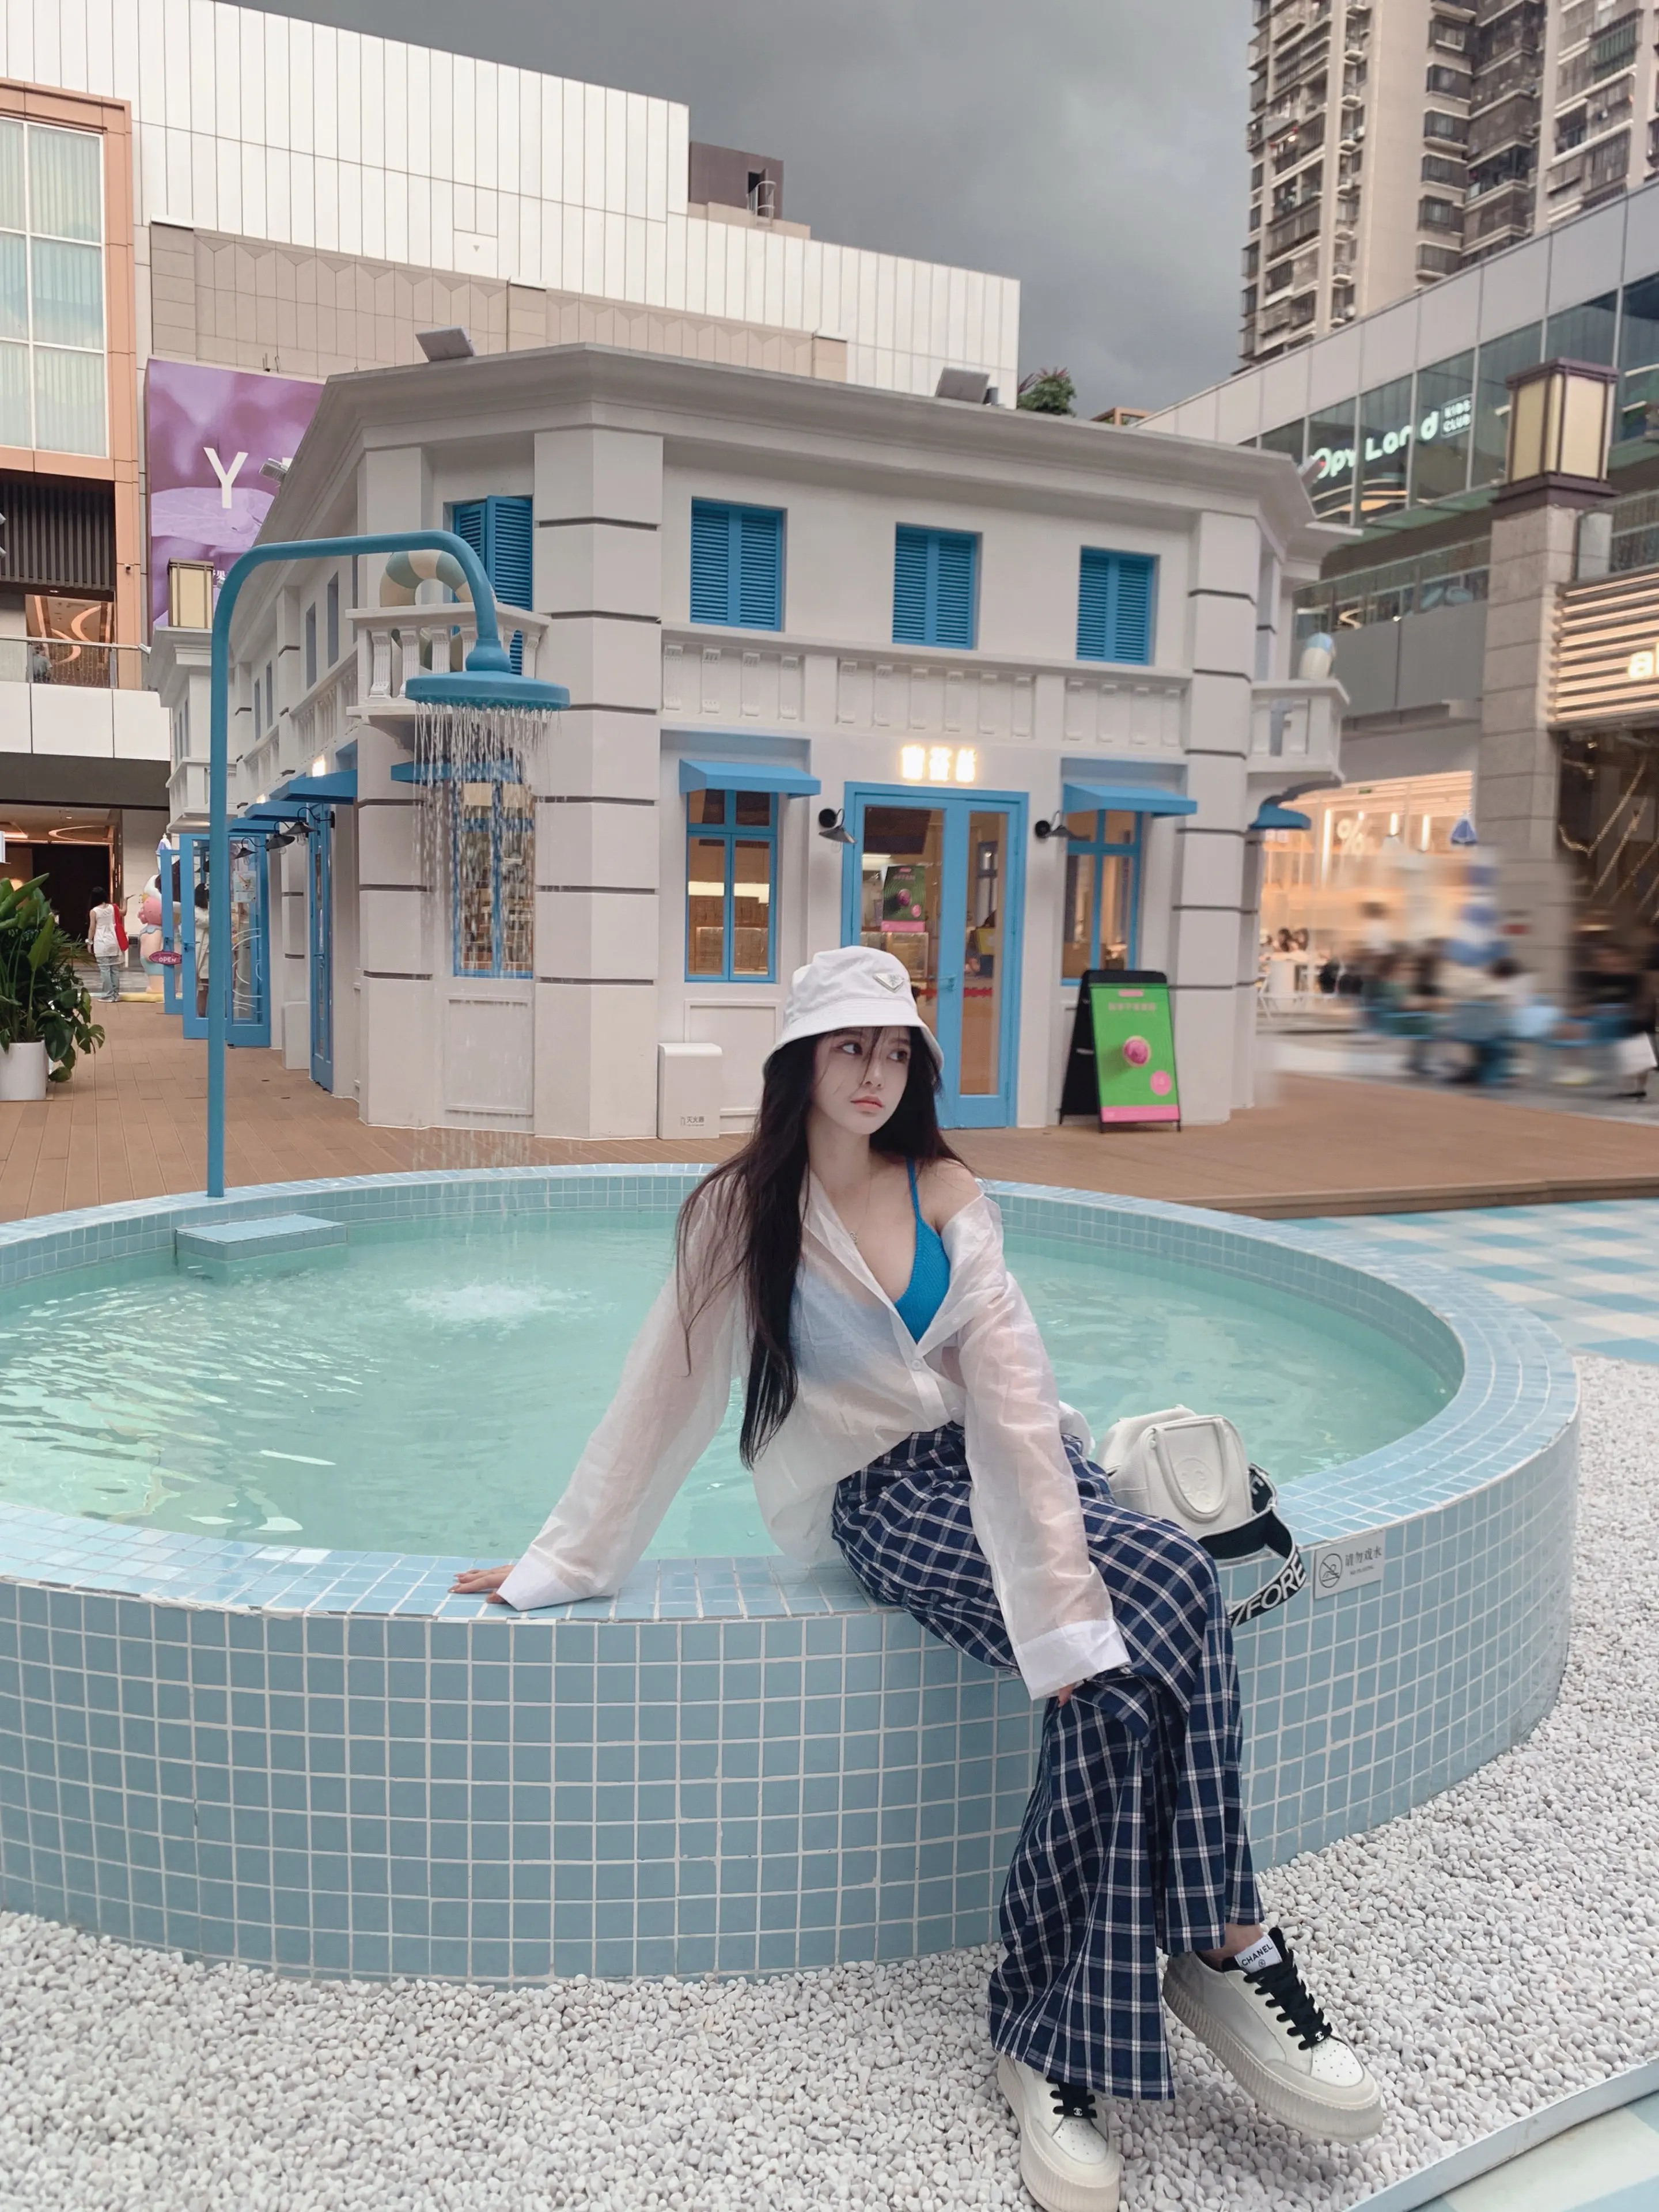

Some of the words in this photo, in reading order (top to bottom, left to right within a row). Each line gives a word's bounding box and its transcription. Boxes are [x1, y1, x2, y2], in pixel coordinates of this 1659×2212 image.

[1445, 399, 1471, 418] KIDS
[1443, 414, 1471, 433] CLUB
[1241, 1944, 1273, 1966] CHANEL
